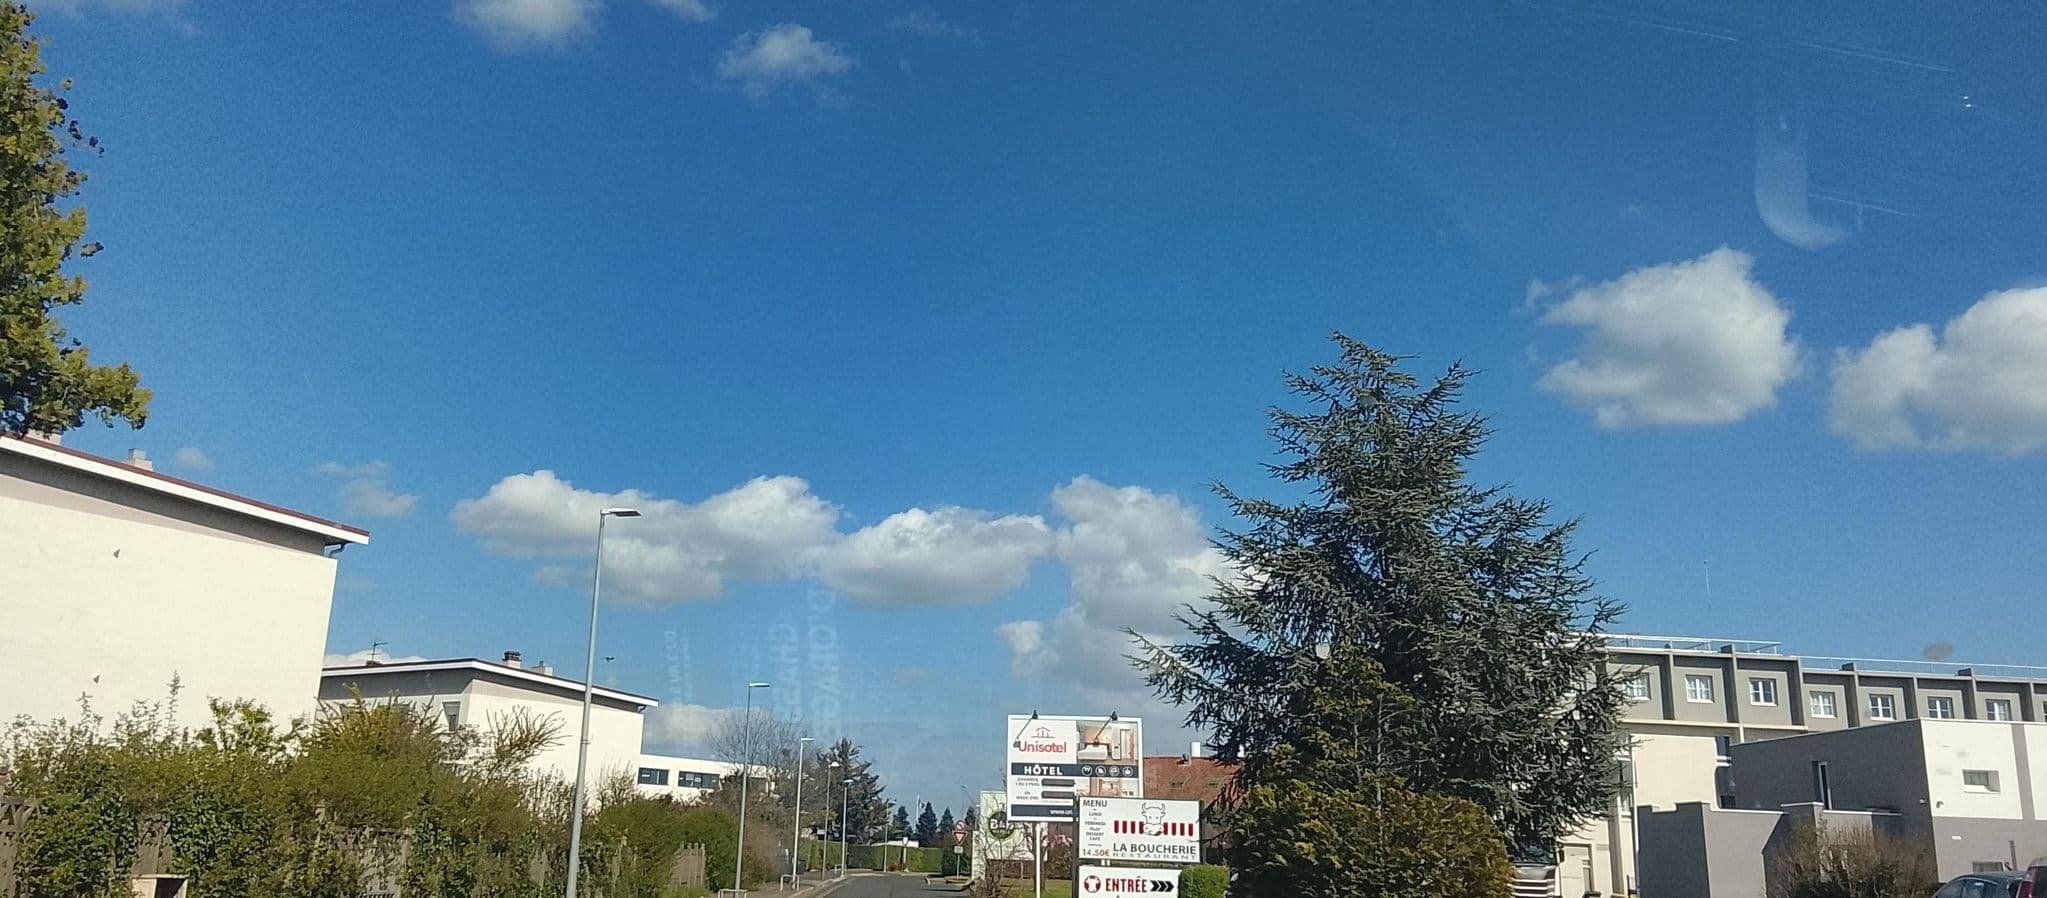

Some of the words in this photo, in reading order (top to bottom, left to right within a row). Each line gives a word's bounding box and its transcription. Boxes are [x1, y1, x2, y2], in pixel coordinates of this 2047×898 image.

[1018, 741, 1067, 753] Unisotel
[1024, 764, 1063, 775] HÔTEL
[1082, 799, 1108, 808] MENU
[1082, 848, 1110, 857] 14.50€
[1113, 842, 1127, 852] LA
[1130, 843, 1197, 855] BOUCHERIE
[1113, 852, 1197, 860] RESTAURANT
[1105, 875, 1148, 893] ENTRÉE
